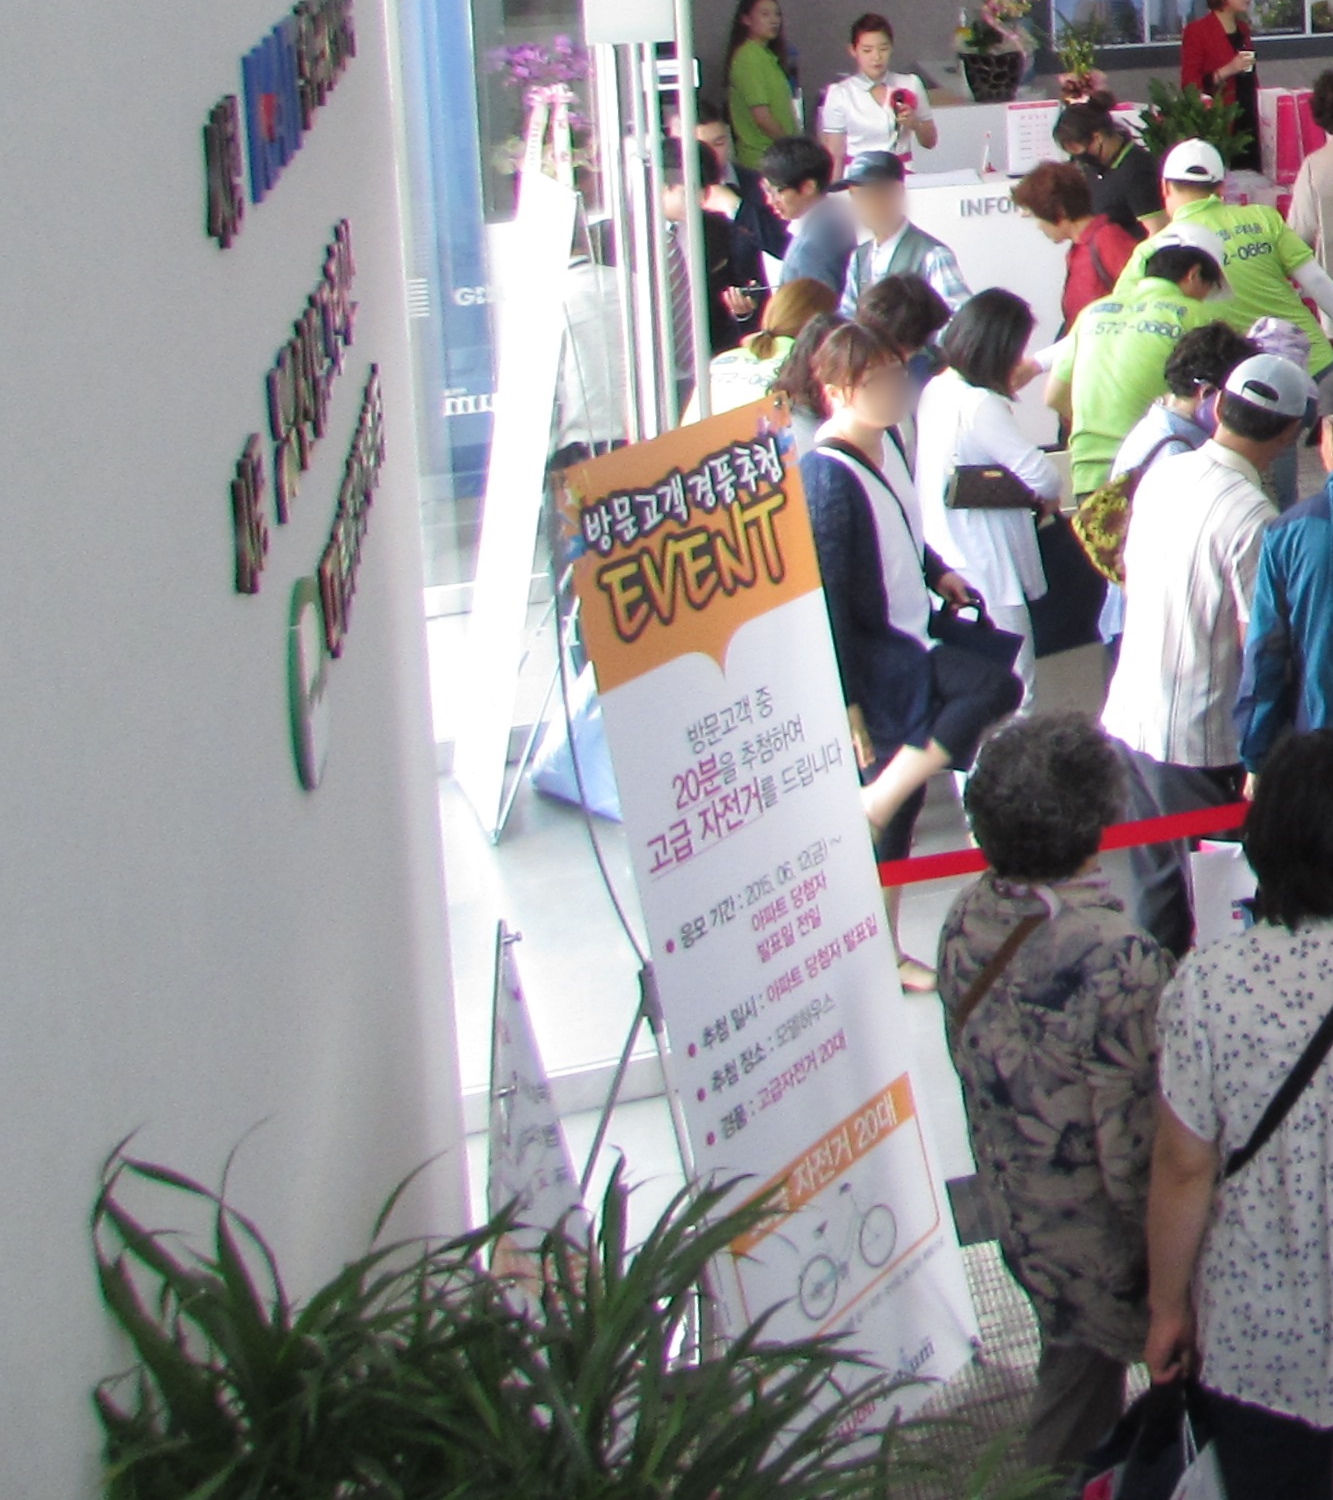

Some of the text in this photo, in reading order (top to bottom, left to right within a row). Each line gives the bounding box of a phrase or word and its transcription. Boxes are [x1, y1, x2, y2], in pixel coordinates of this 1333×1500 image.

[582, 437, 785, 556] 방문고객 경품추첨
[599, 493, 786, 644] EVENT
[672, 714, 805, 810] 20분을 추첨하여
[687, 686, 773, 754] 방문고객 중
[647, 738, 842, 874] 고급 자전거를 드립니다
[680, 916, 708, 949] 응모
[752, 870, 828, 932] 아파트 당첨자
[757, 904, 822, 963] 발표일 전일
[702, 1015, 730, 1049] 추첨
[766, 966, 804, 1002] 아파트
[805, 938, 843, 980] 당첨자
[843, 913, 879, 953] 발표일
[711, 1059, 740, 1093] 추첨
[776, 993, 837, 1048] 모델하우스
[758, 1050, 819, 1111] 고급자전거
[820, 1027, 848, 1064] 20대
[792, 1090, 898, 1196] 자전거 20대
